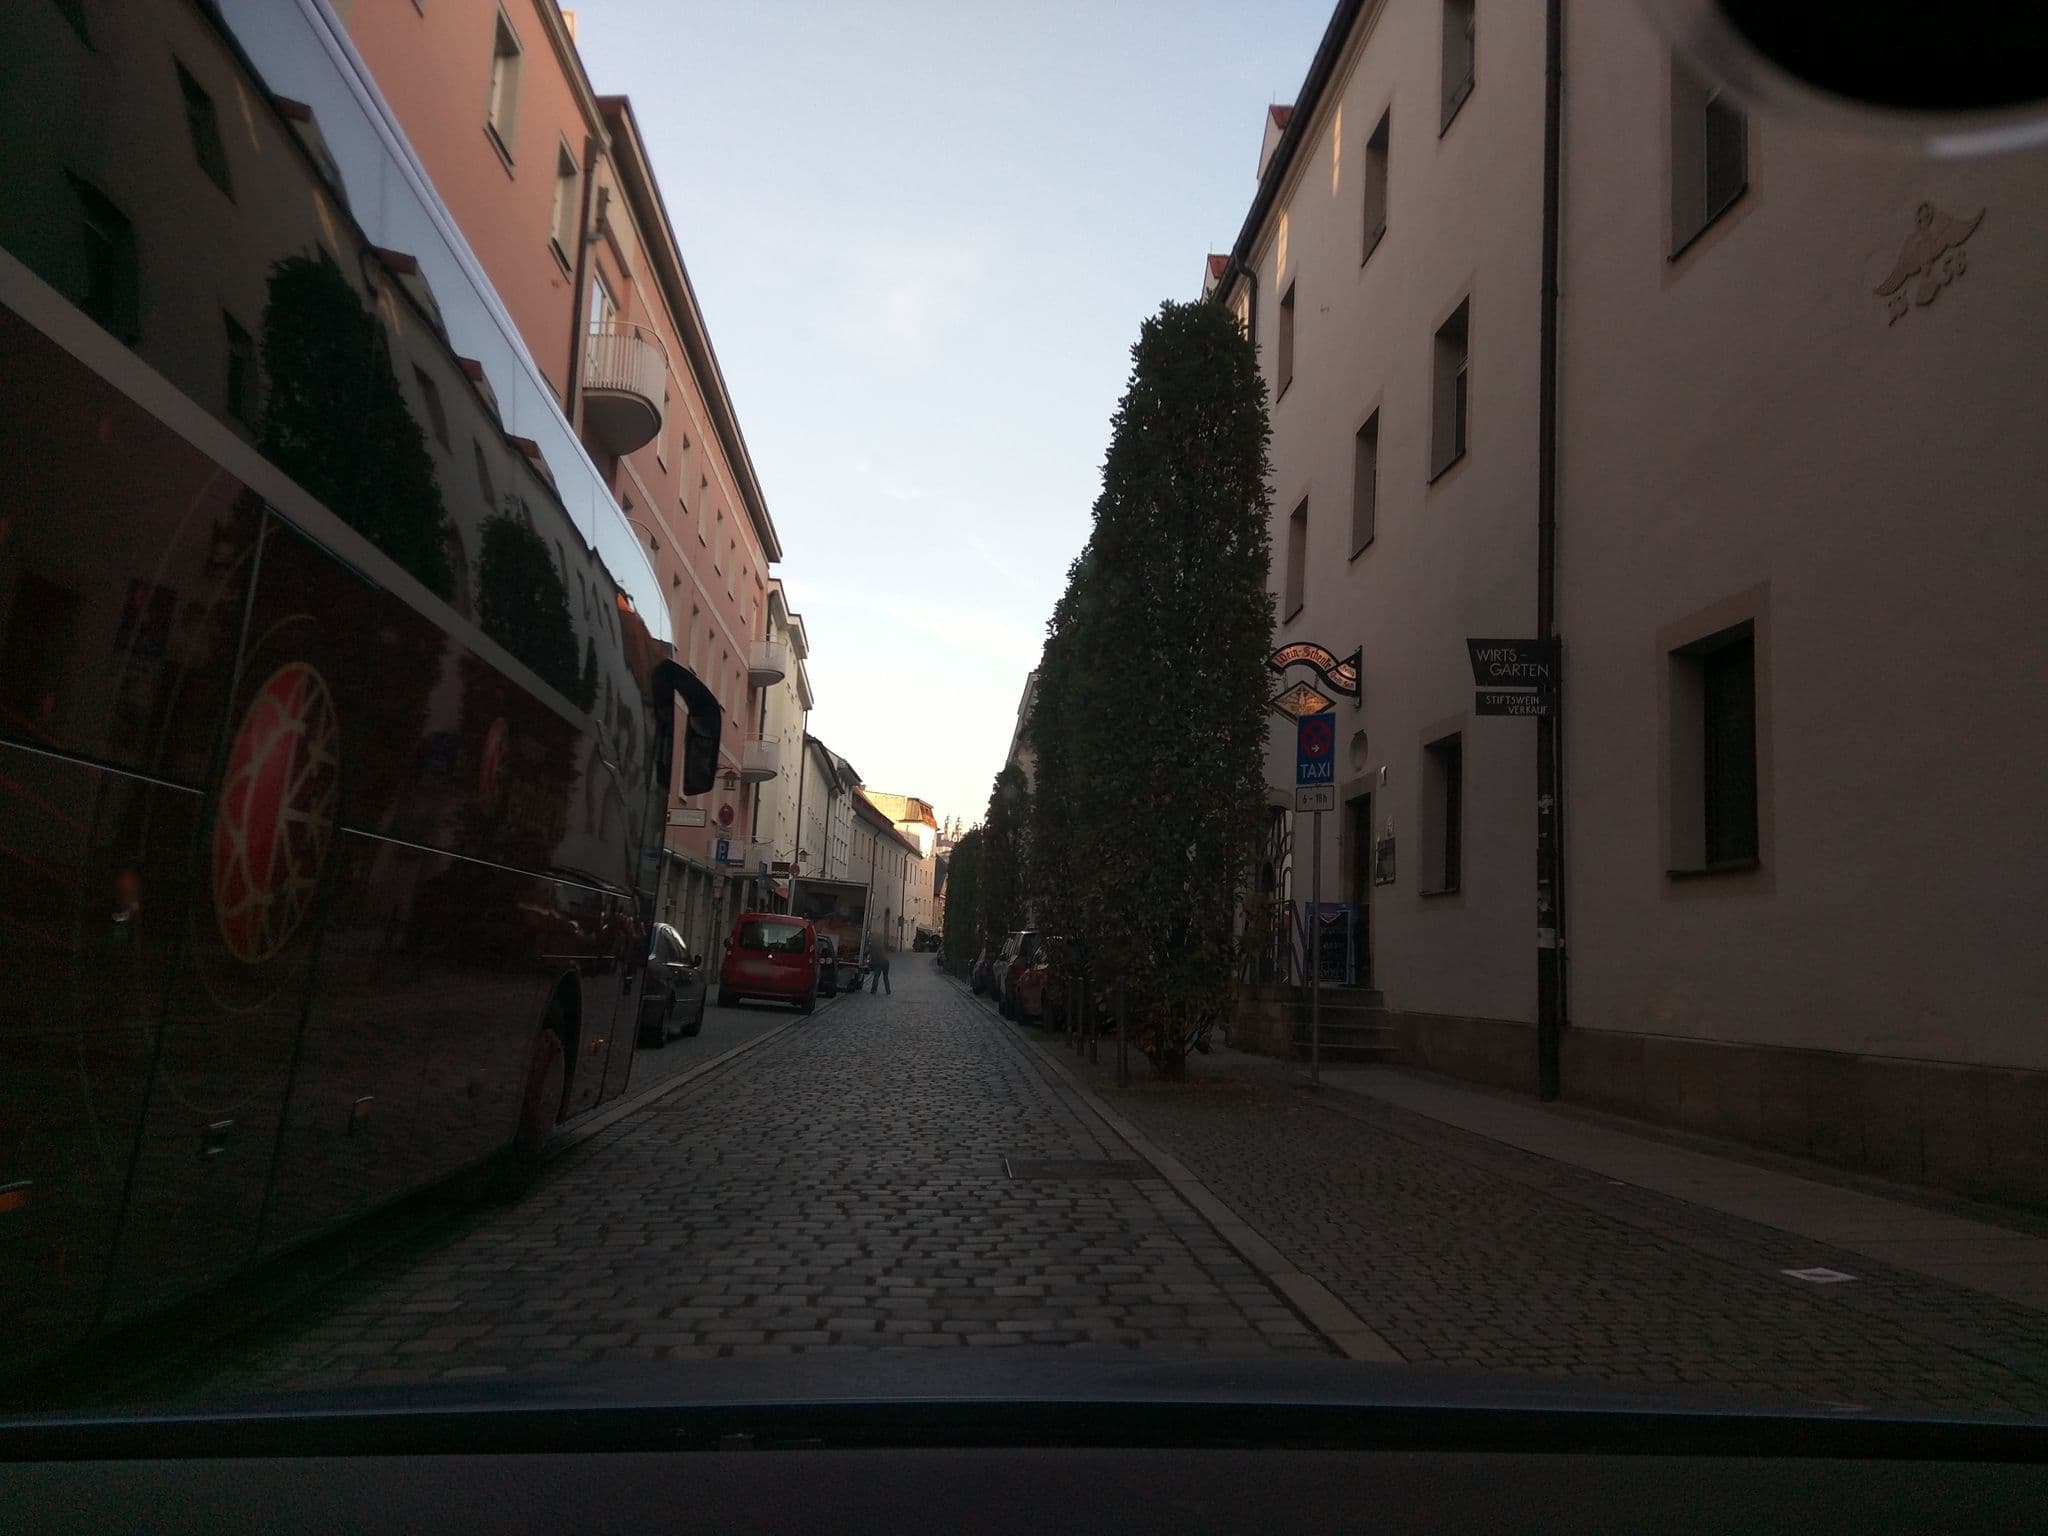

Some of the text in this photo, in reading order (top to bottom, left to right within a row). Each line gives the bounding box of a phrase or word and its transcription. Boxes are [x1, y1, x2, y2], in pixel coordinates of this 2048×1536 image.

[1489, 663, 1549, 677] GARTEN
[1508, 704, 1549, 715] VERKAUF
[1300, 761, 1330, 778] TAXI
